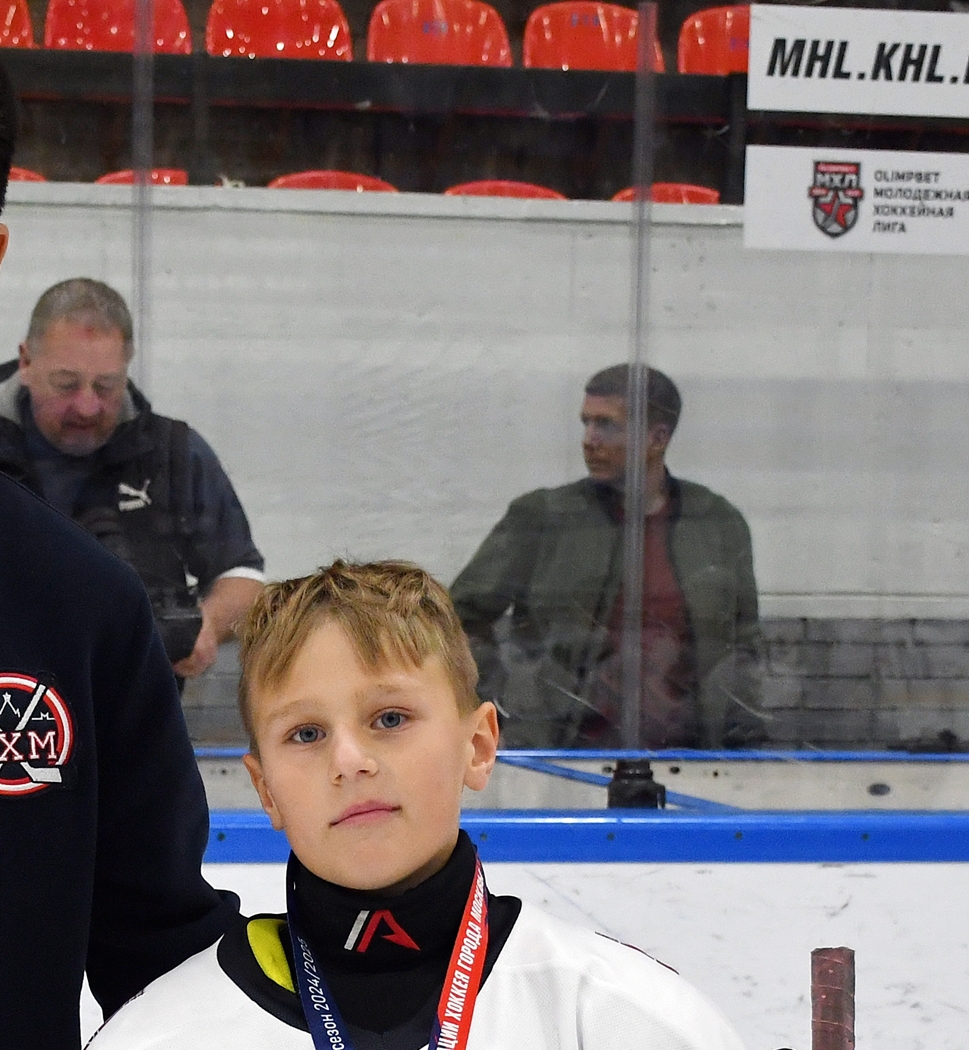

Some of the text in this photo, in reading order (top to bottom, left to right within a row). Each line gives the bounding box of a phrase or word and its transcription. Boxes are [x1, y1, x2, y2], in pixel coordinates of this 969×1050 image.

[767, 37, 969, 84] MHL.KHL.
[873, 220, 907, 233] ЛИГА
[444, 973, 470, 1022] ХОККЕЯ
[457, 921, 483, 972] ГОРОДА
